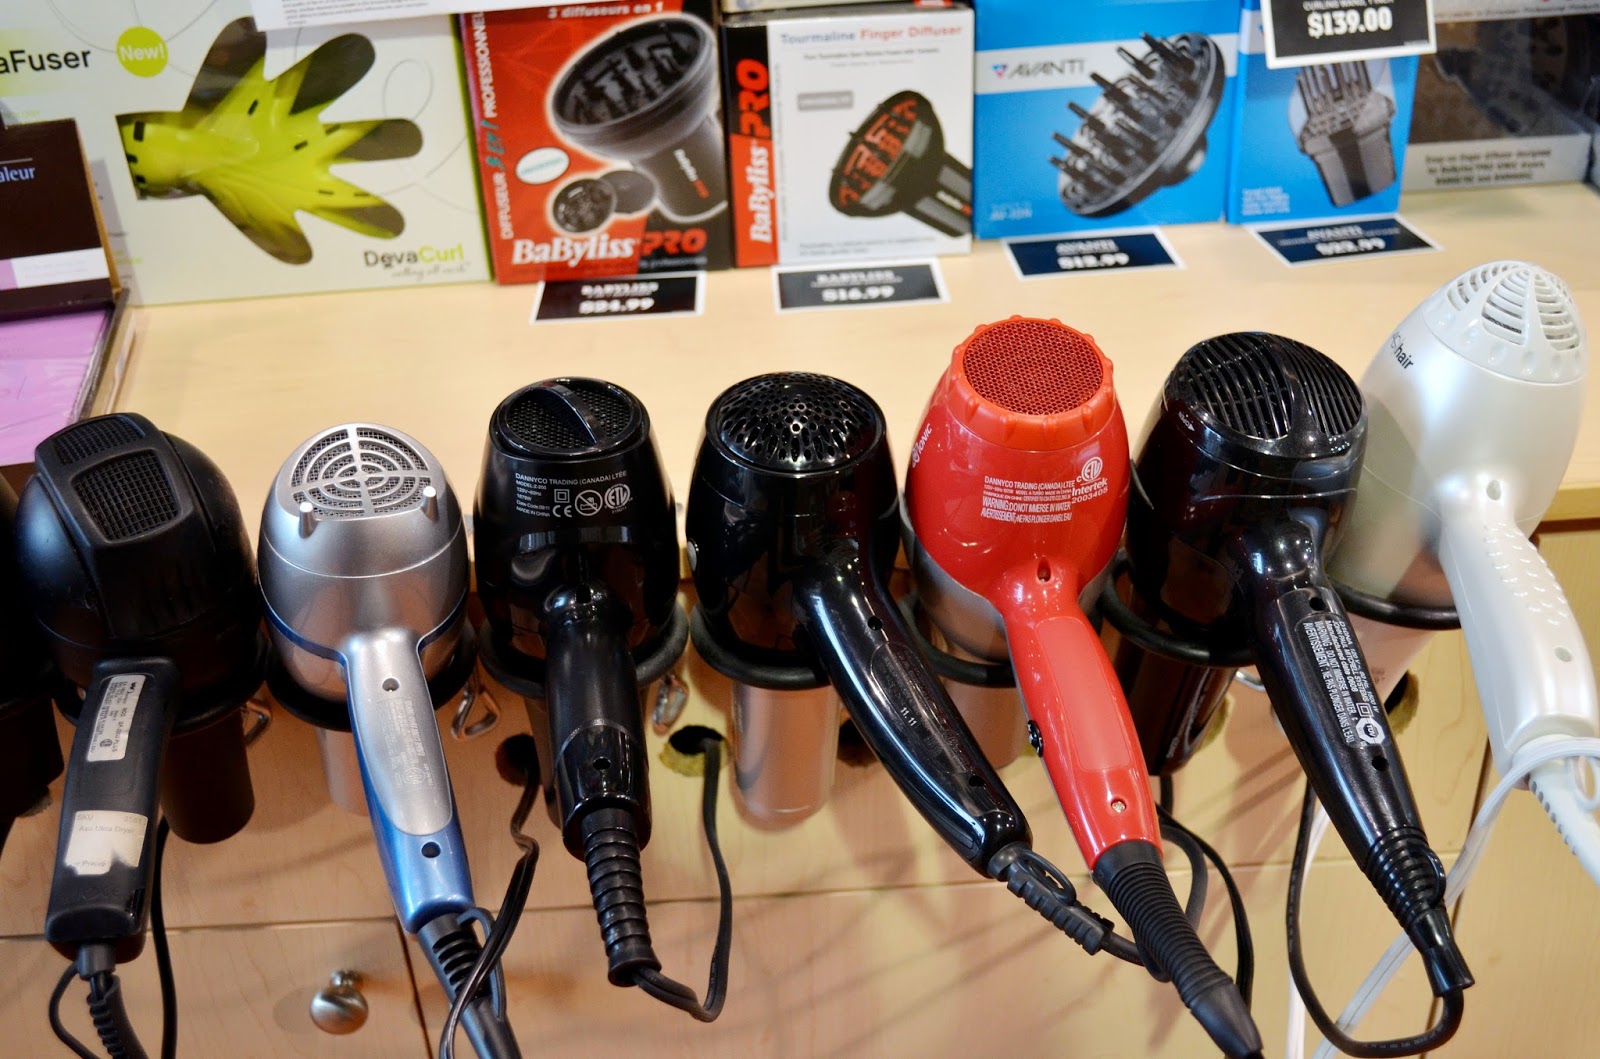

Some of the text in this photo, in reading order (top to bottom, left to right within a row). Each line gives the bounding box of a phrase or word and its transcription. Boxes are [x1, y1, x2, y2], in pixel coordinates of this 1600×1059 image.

[1307, 7, 1393, 39] $139.00
[781, 26, 962, 44] Tourmaline Finger Diffuser
[119, 43, 165, 62] New!
[1008, 58, 1085, 79] AVANTI
[736, 58, 771, 138] PRO
[746, 144, 776, 242] BaByliss
[492, 172, 514, 240] DIFFUSEUR
[364, 243, 464, 268] DevaCurl
[512, 228, 707, 267] BaByliss PRO
[515, 472, 548, 484] DANNYCO
[549, 478, 578, 486] TRADING
[580, 474, 612, 485] (CANADA)
[984, 476, 1013, 488] DANNYCO
[1014, 482, 1038, 490] TRADING
[1038, 482, 1063, 490] (CANADA)
[1072, 478, 1108, 496] Intertek
[516, 506, 530, 514] MADE
[1017, 503, 1028, 512] NOT
[1028, 504, 1050, 512] IMMERSE
[1323, 620, 1346, 660] Manufactured
[1340, 661, 1351, 674] date
[1325, 649, 1335, 658] DO
[1329, 658, 1339, 668] NOT
[1331, 620, 1369, 702] JOHN PAUL MITCHELL SYSTEMS
[1321, 670, 1331, 679] NE
[1324, 678, 1335, 689] PAS
[1332, 667, 1347, 690] IMMERSE
[1327, 688, 1344, 713] PLONGER
[1336, 711, 1349, 727] DANS
